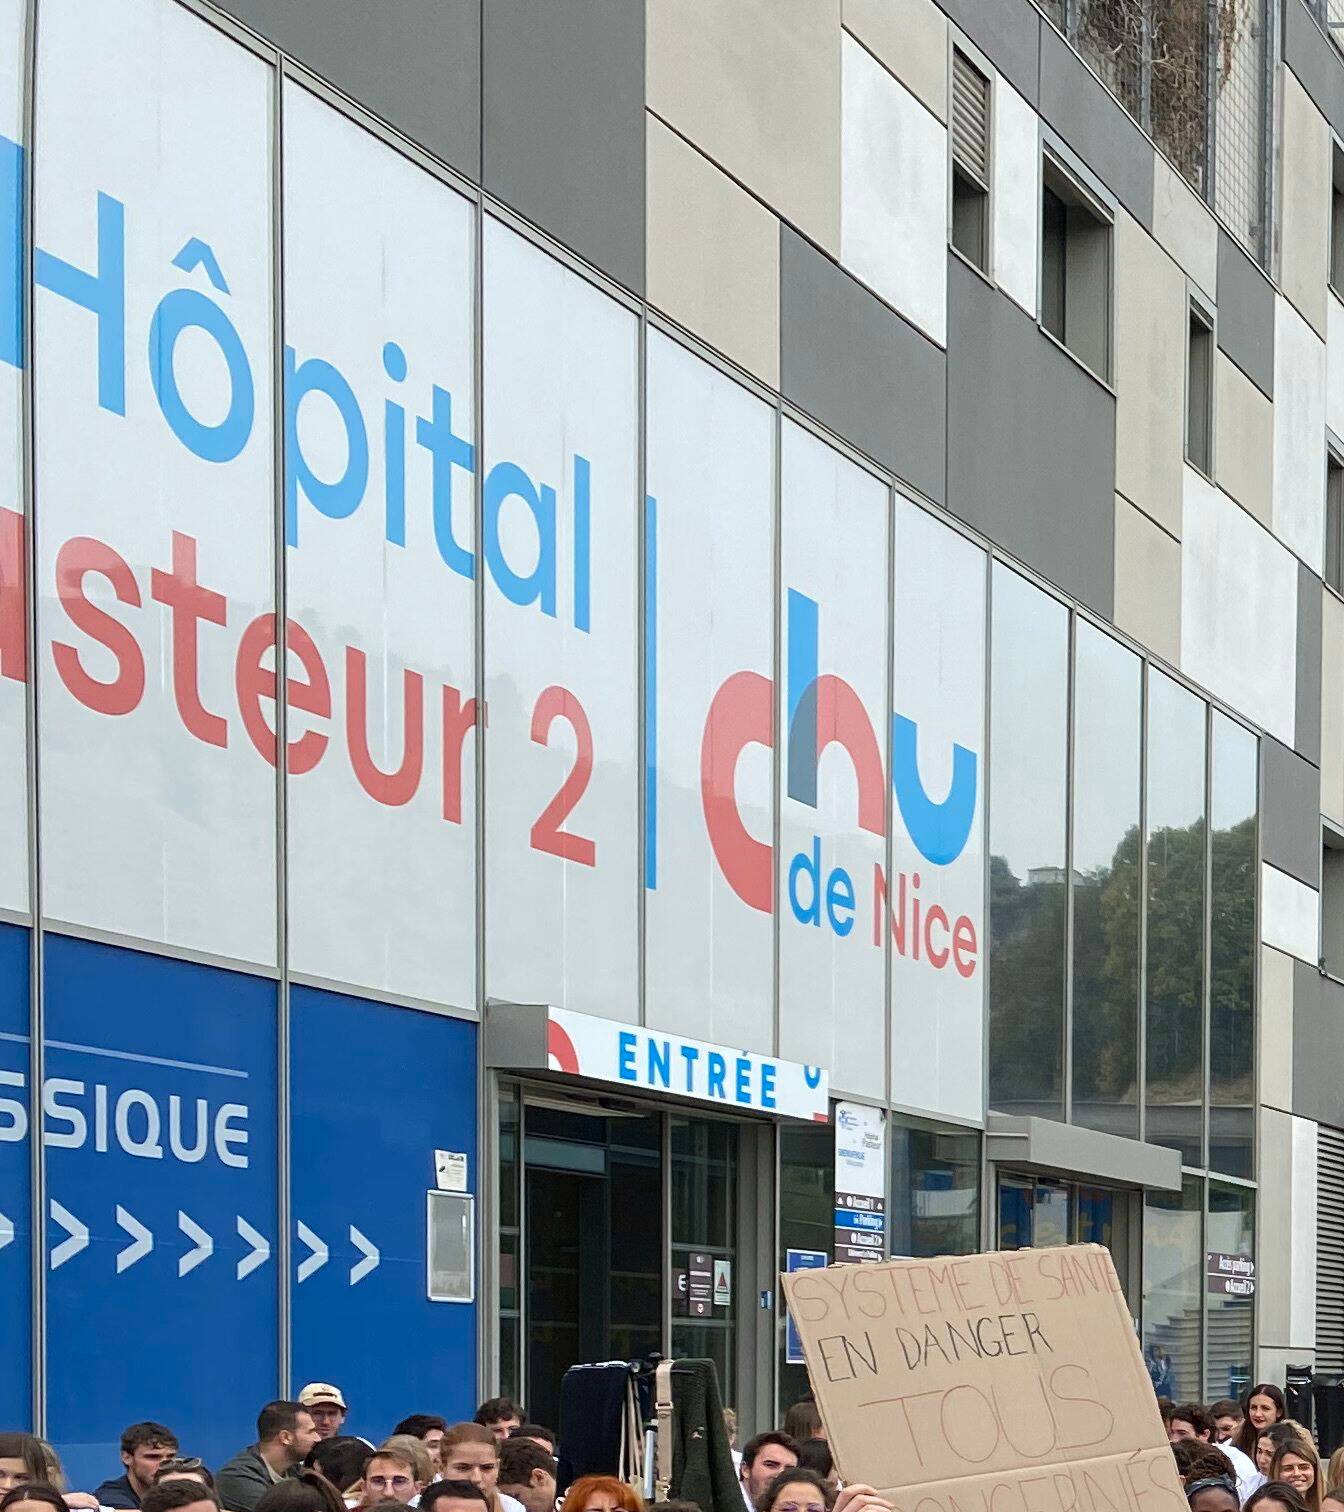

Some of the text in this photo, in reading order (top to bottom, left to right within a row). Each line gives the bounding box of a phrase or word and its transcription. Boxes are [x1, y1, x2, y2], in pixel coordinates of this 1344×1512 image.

[0, 135, 591, 634] Hôpital
[530, 685, 596, 867] 2
[700, 587, 977, 915] chu
[788, 836, 978, 978] de Nice
[618, 1031, 776, 1109] ENTRÉE
[989, 1258, 1023, 1307] DE
[817, 1313, 1053, 1382] EN DANGER
[858, 1364, 1114, 1467] TOUS
